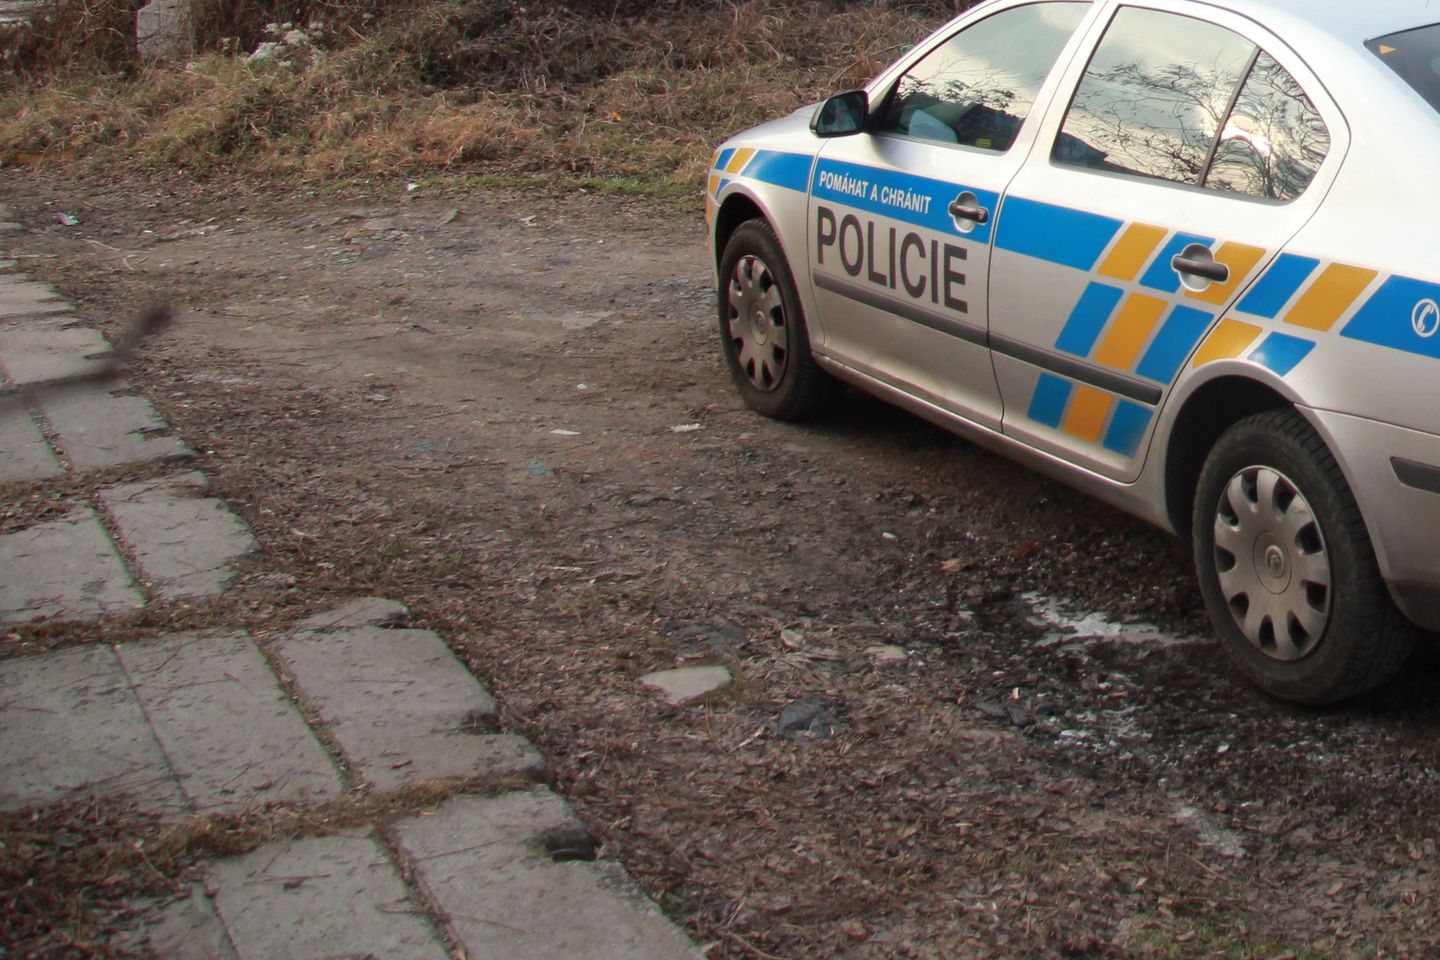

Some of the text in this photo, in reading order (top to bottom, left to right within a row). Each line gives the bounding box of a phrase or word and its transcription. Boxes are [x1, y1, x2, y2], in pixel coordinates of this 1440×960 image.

[818, 170, 932, 214] POMÁHAT A CHRÁNIT
[817, 205, 969, 314] POLICIE
